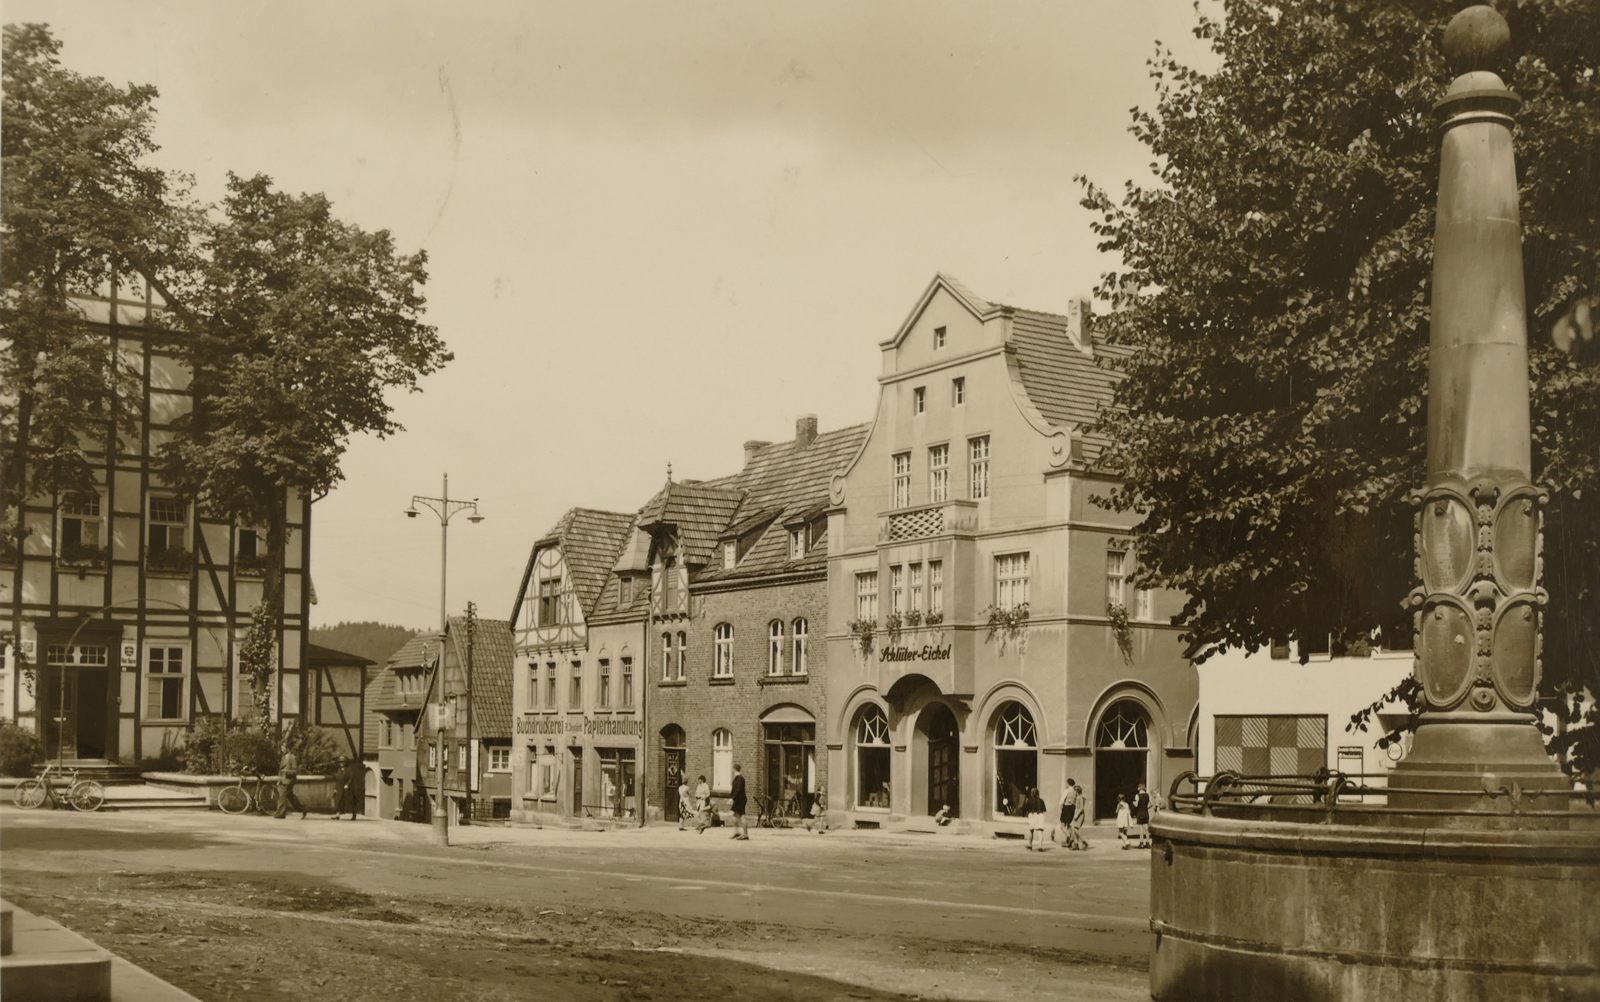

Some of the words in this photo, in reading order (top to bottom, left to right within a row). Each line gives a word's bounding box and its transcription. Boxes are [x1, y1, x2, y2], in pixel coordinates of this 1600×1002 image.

[435, 706, 449, 728] P
[517, 717, 564, 735] Buchdruckerei
[584, 716, 643, 739] Papierhandlung
